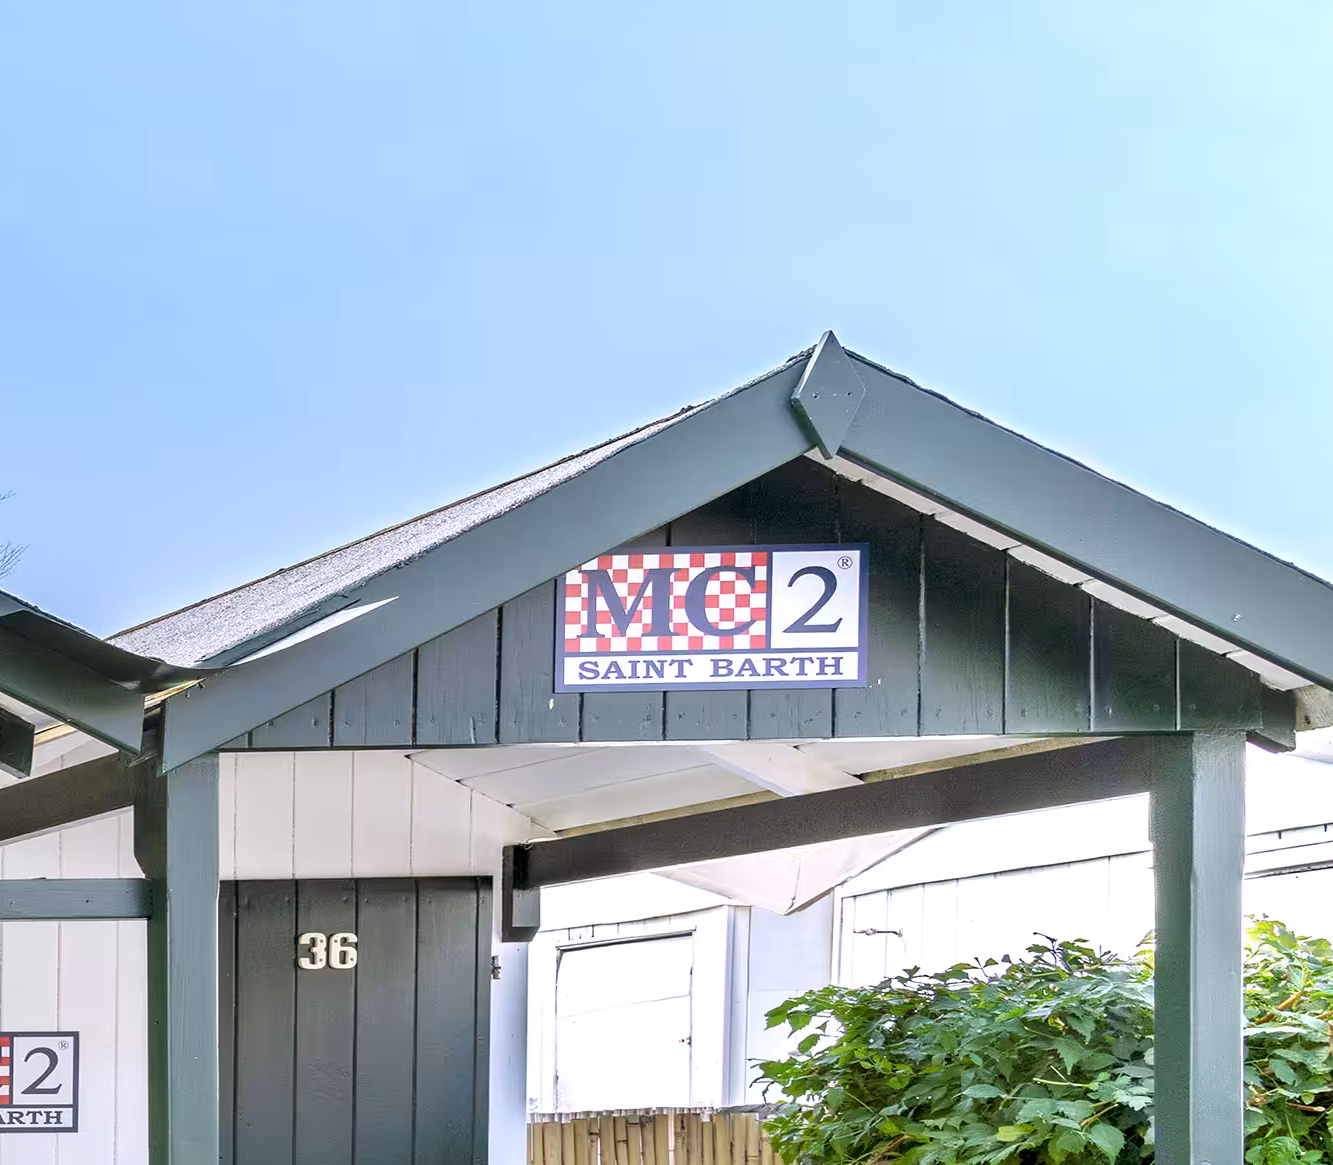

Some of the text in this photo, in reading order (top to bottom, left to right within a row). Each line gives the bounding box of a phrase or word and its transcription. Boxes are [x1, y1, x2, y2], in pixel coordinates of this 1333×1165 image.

[578, 656, 844, 680] SAINT BARTH
[298, 932, 358, 970] 36
